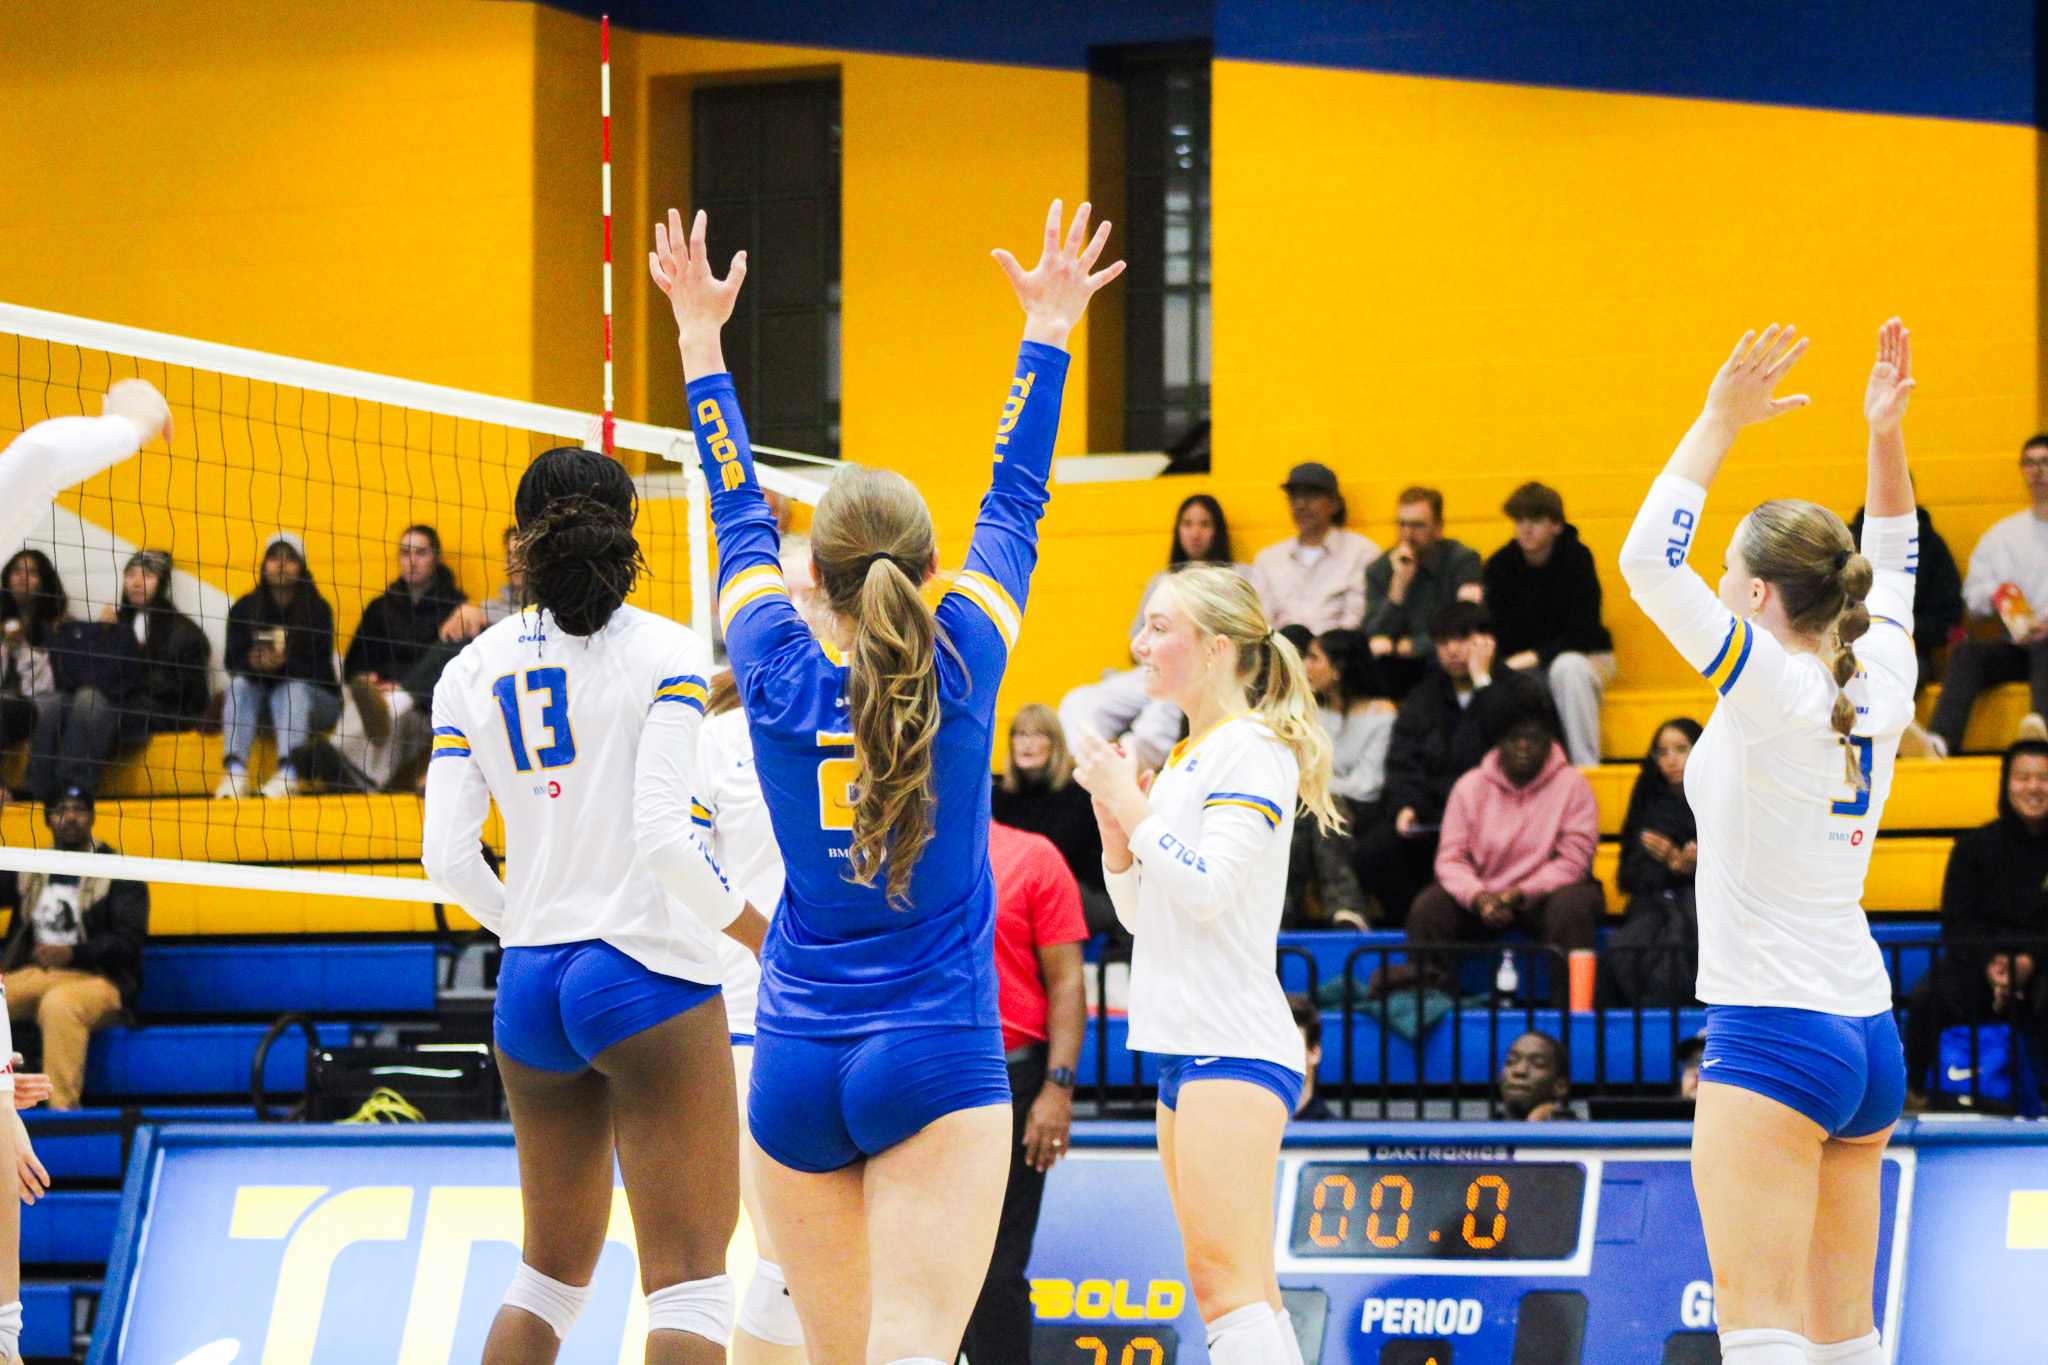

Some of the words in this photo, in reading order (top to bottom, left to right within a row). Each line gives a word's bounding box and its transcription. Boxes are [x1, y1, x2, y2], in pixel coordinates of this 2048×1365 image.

[491, 665, 579, 774] 13
[1829, 733, 1874, 819] 3
[1376, 1146, 1508, 1160] DAKTRONICS
[1029, 1279, 1185, 1319] BOLD
[1361, 1298, 1483, 1335] PERIOD
